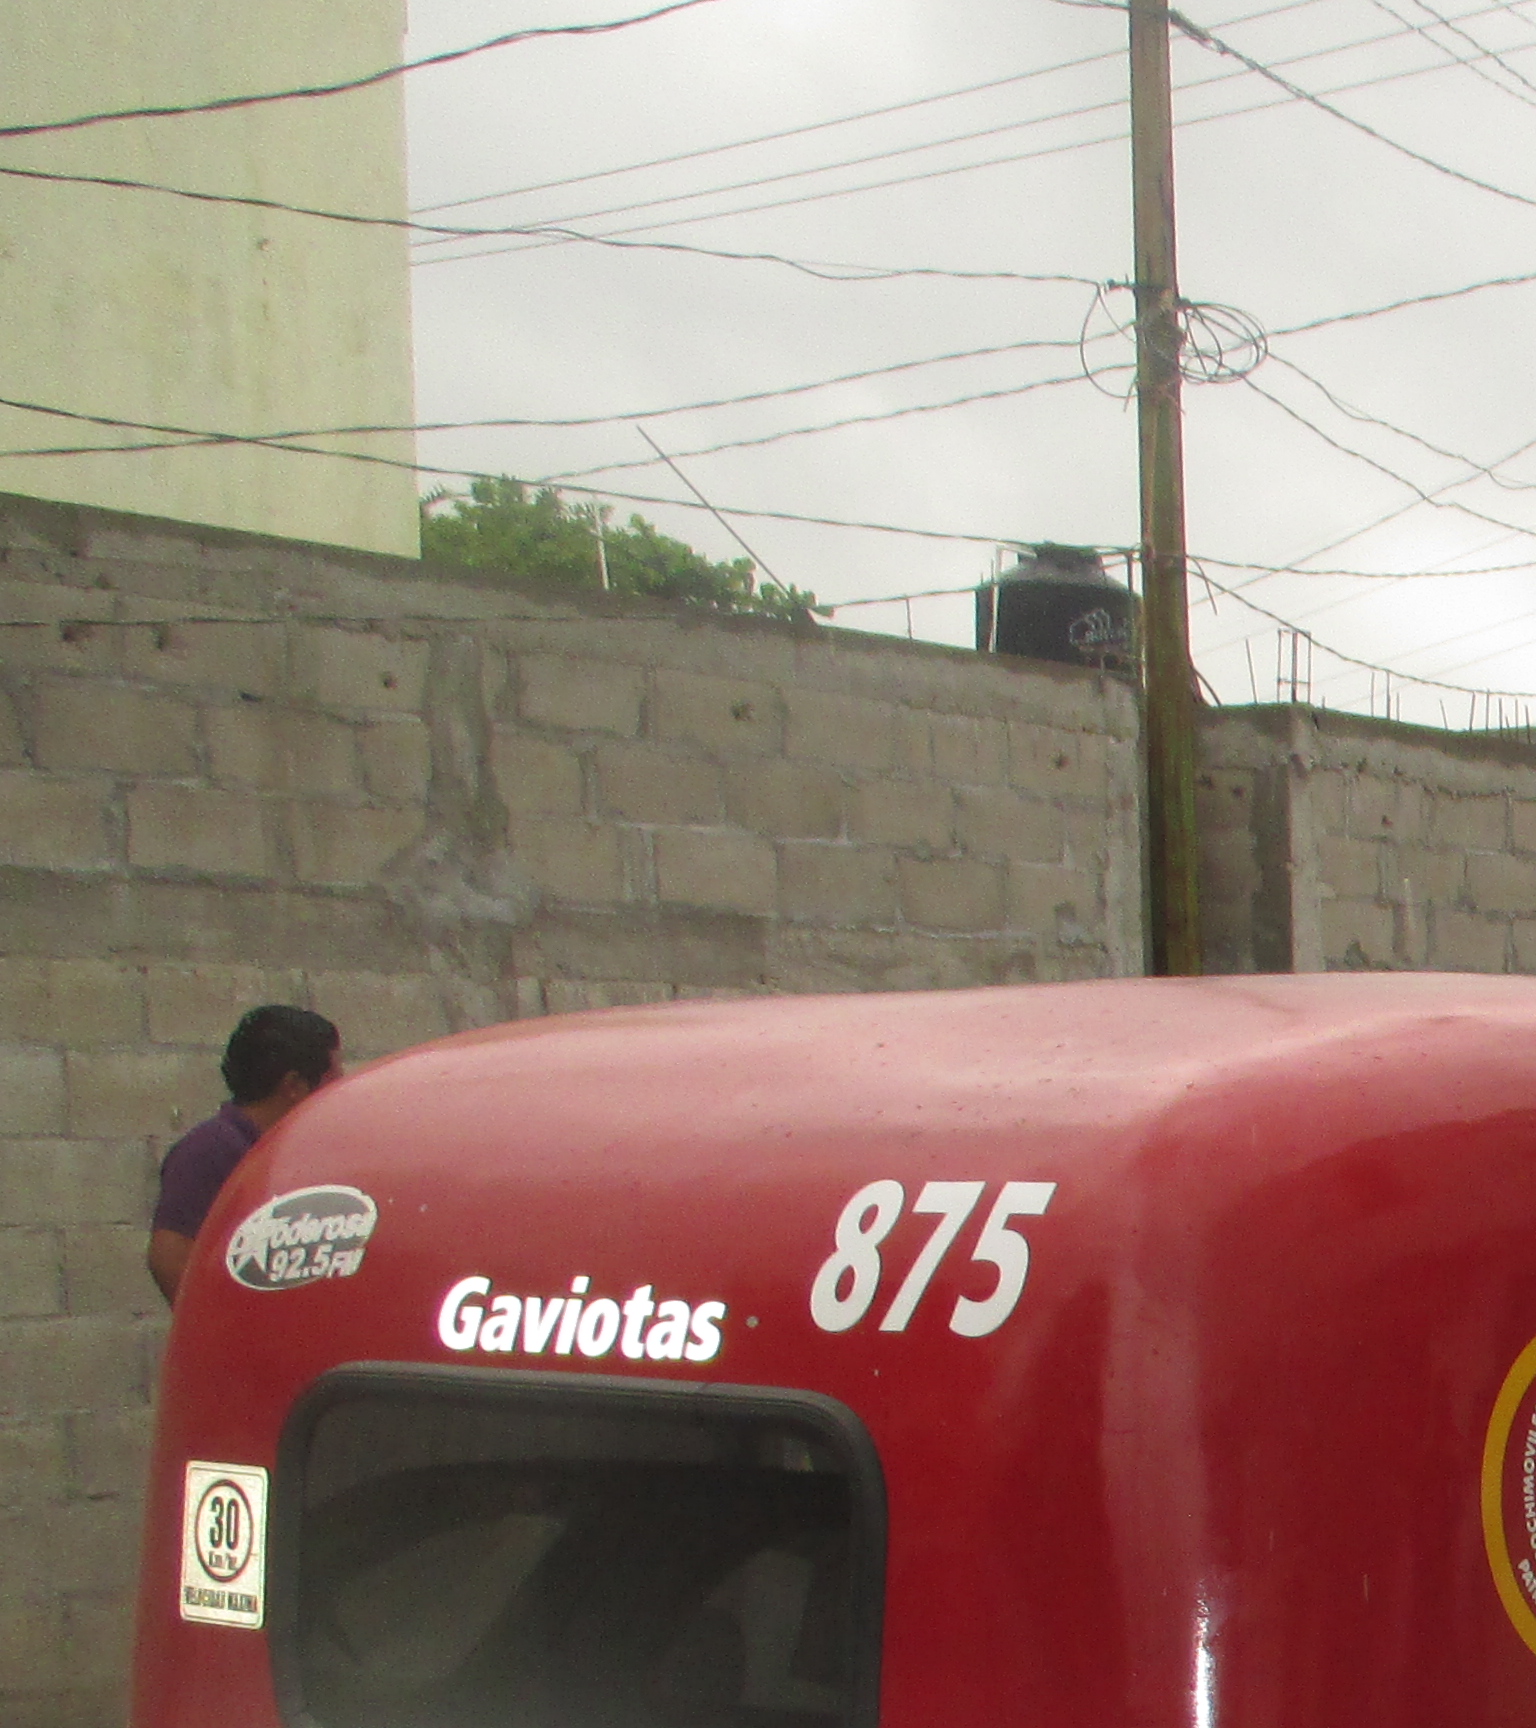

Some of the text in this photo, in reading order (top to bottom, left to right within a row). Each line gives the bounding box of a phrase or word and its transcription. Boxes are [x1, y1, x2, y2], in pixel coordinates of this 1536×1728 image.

[810, 1179, 1057, 1338] 875
[437, 1274, 728, 1363] Gaviotas
[209, 1495, 240, 1550] 30
